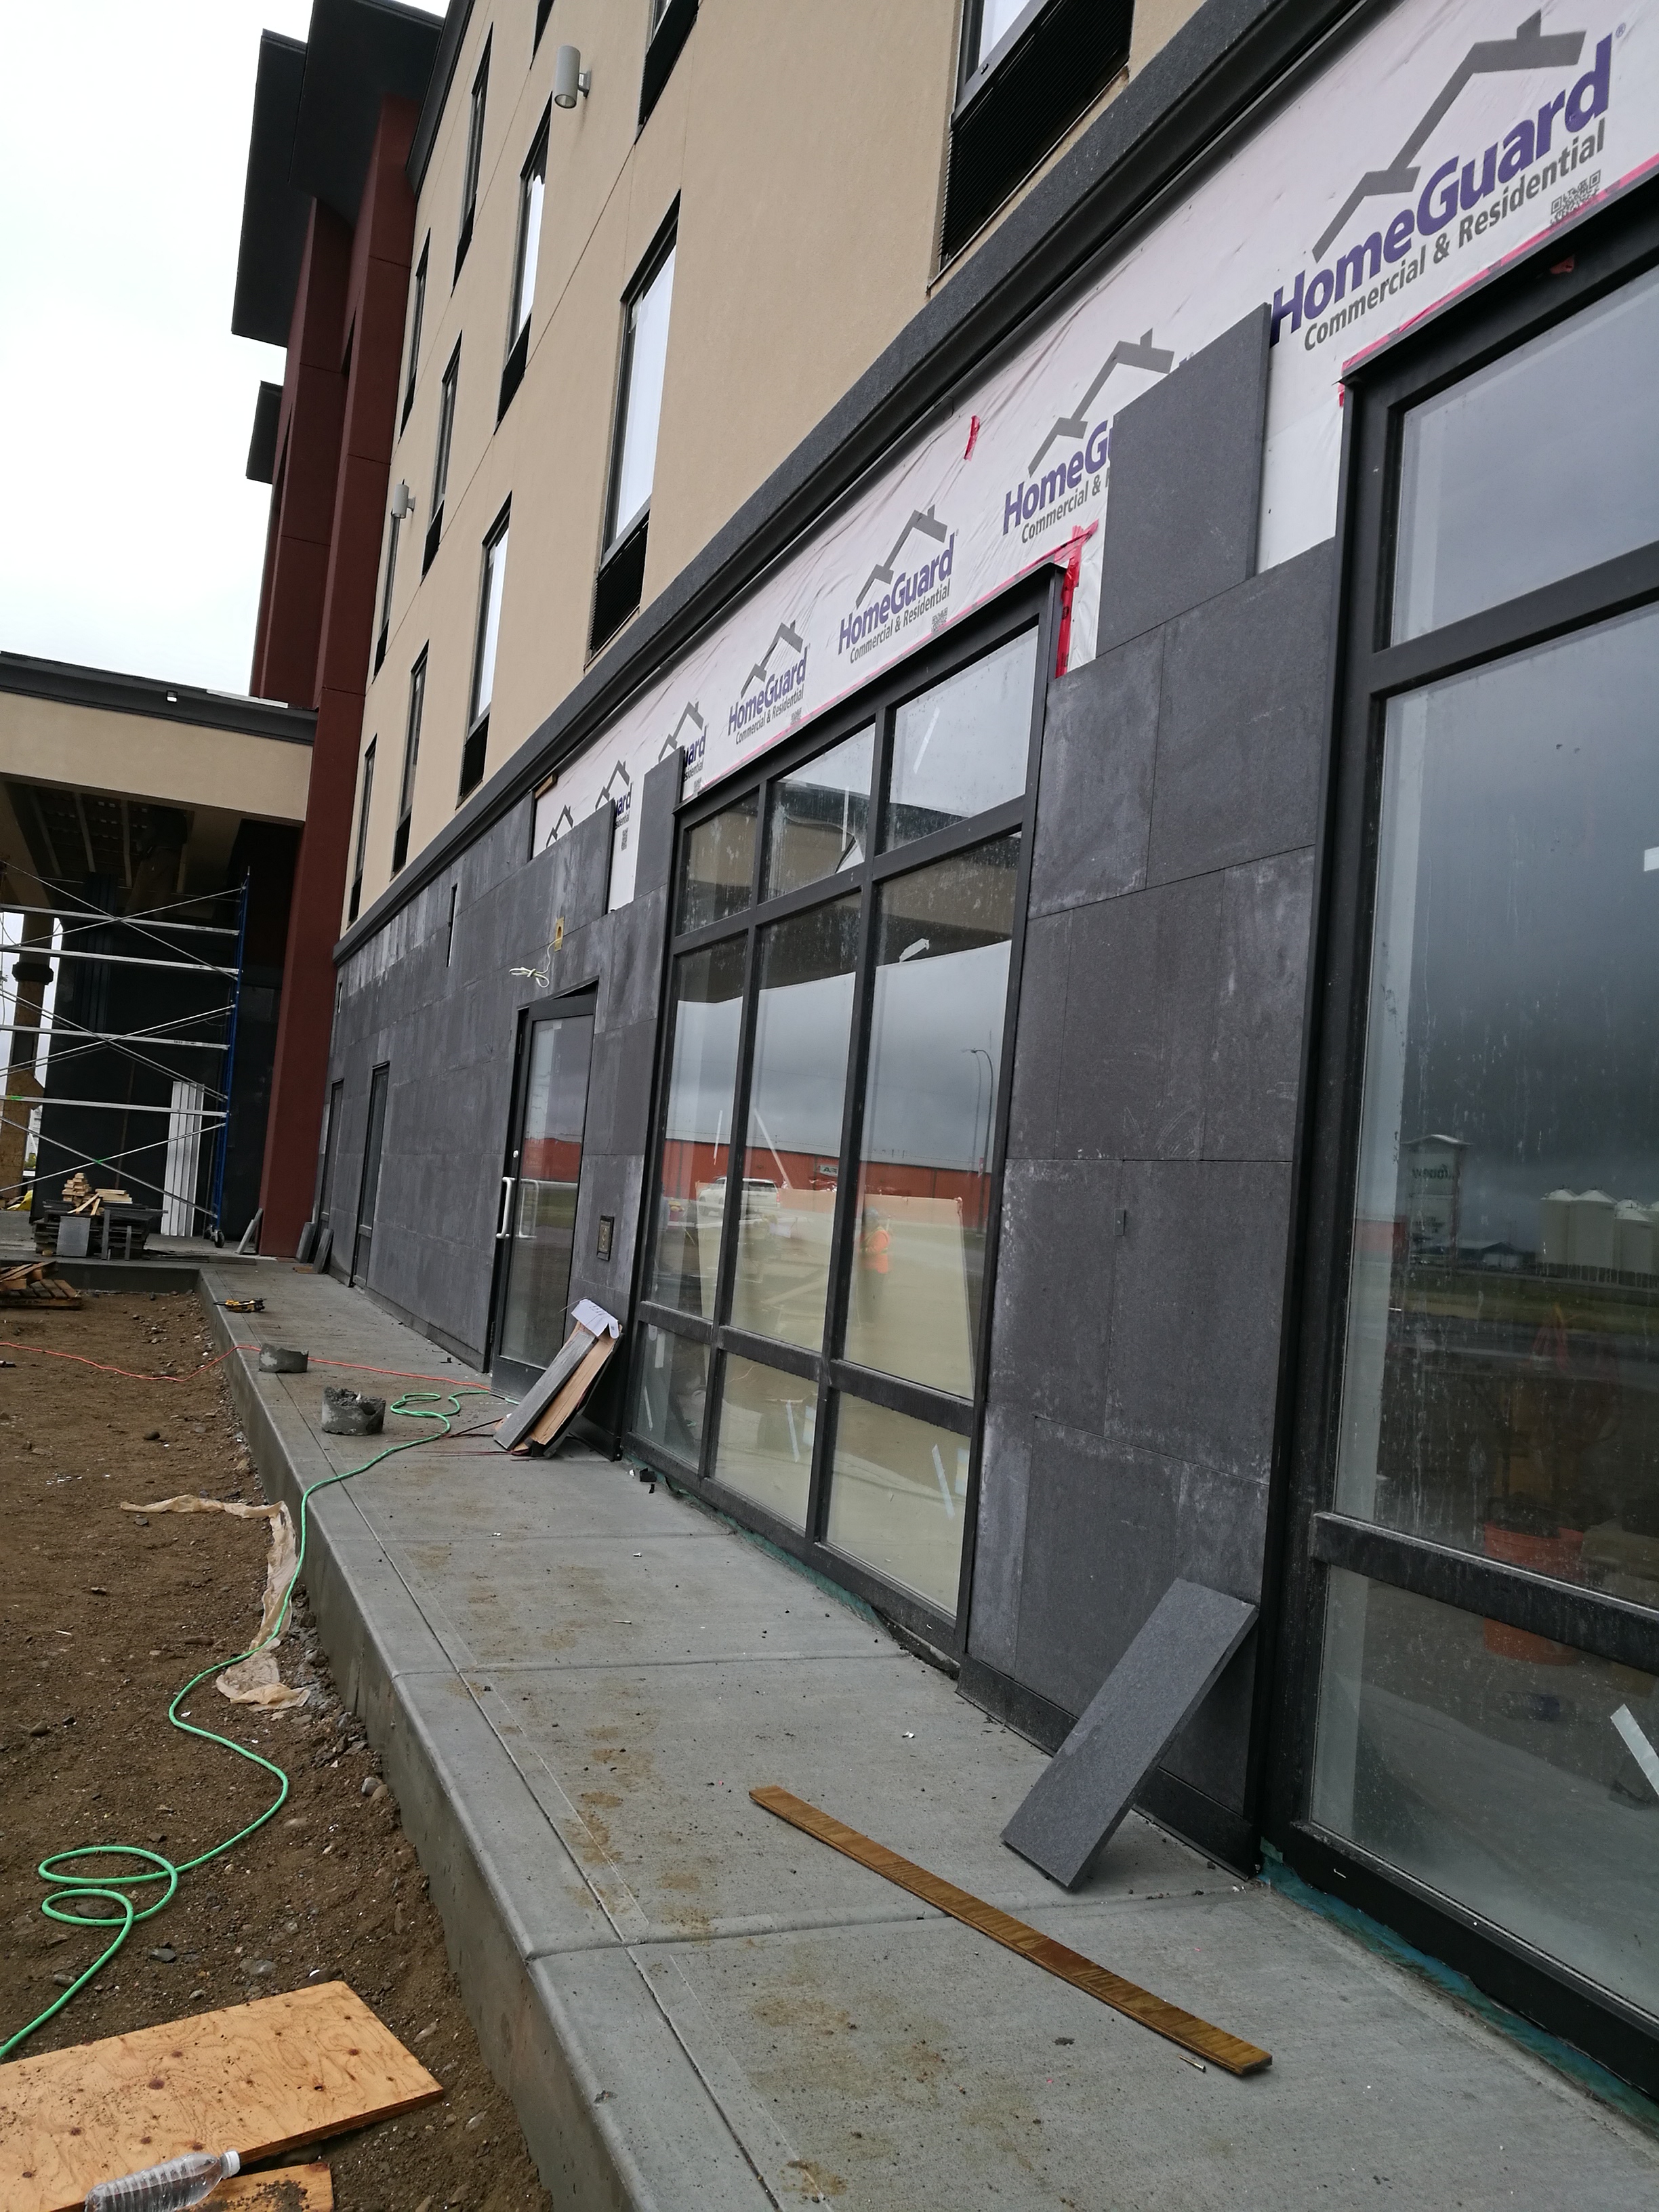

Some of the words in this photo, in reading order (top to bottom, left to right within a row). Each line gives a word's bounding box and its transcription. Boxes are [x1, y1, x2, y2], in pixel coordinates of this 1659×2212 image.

[1269, 33, 1612, 348] HomeGuard
[1304, 245, 1425, 351] Commercial
[1433, 233, 1450, 265] &
[1458, 118, 1605, 248] Residential
[1002, 420, 1112, 535] HomeG
[1021, 480, 1088, 544] Commercial
[1092, 474, 1101, 496] &
[838, 532, 955, 655] HomeGuard
[850, 619, 893, 663] Commercial
[895, 615, 901, 633] &
[903, 579, 951, 627] Residential
[729, 646, 807, 735] HomeGuard
[736, 712, 766, 745] Commercial
[772, 684, 804, 719] Residential
